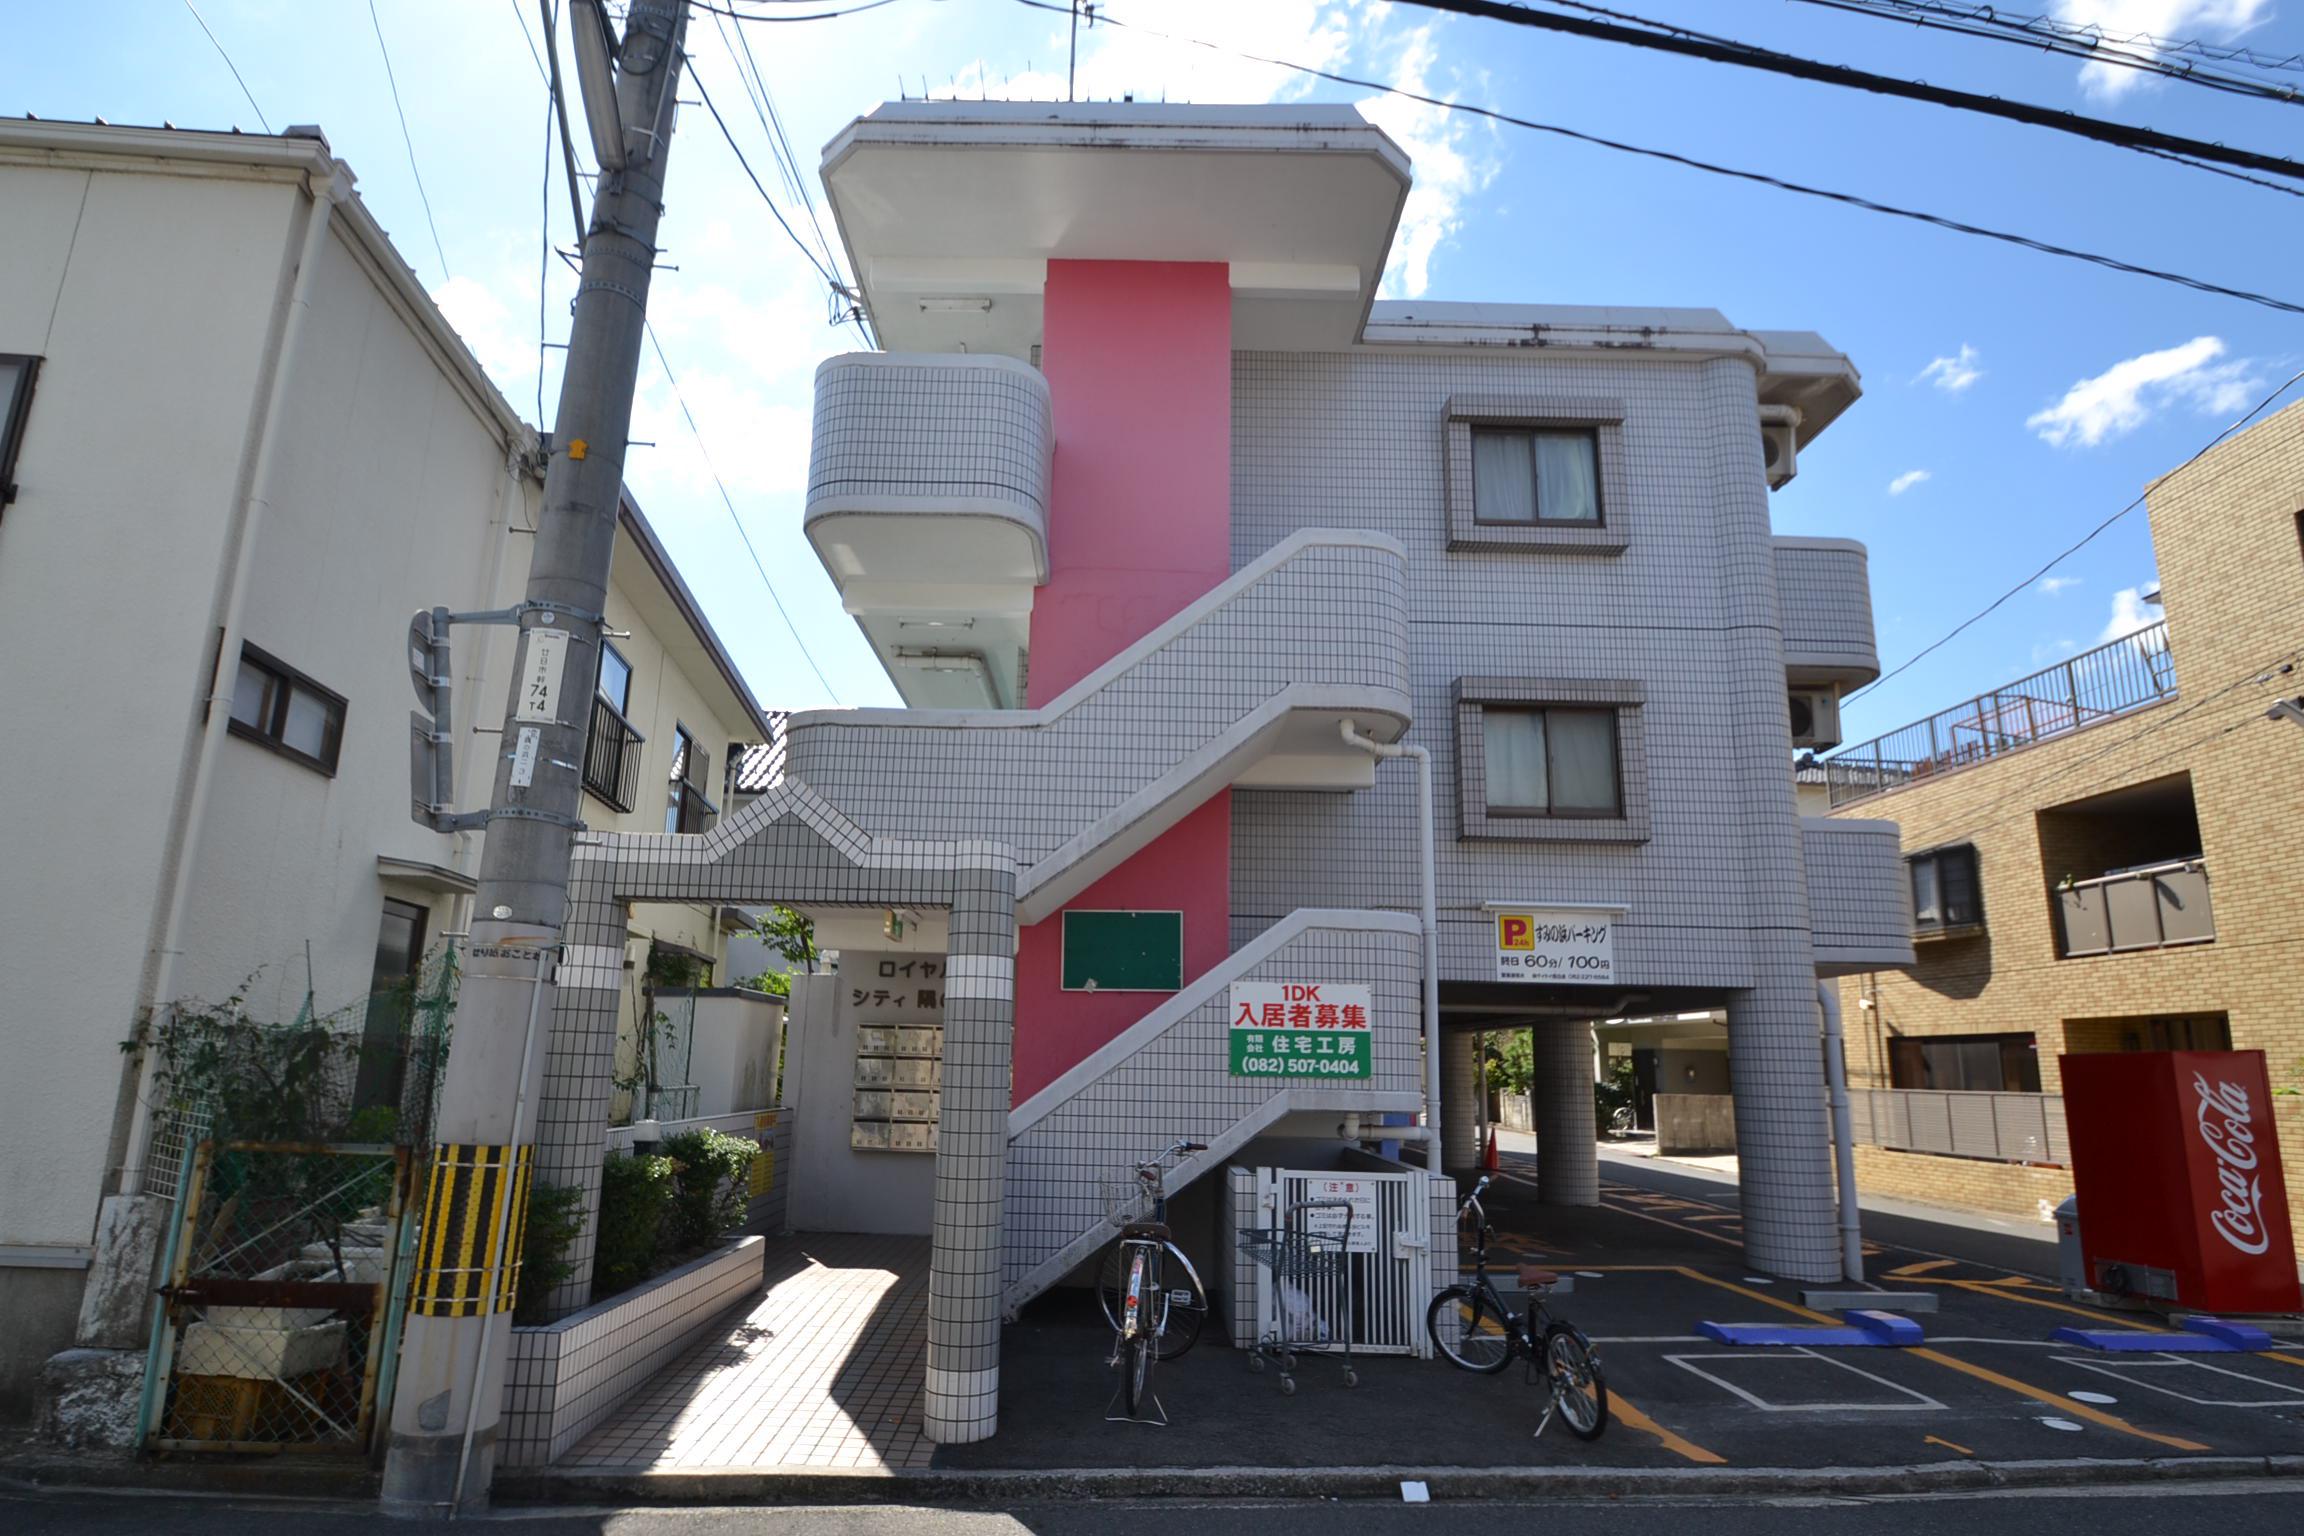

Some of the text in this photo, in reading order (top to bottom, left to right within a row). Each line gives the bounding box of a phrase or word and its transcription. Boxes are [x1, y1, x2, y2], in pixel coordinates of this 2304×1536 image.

[530, 684, 548, 698] 74
[529, 700, 546, 712] T4
[1282, 985, 1320, 1002] 1DK
[1234, 1003, 1367, 1029] 入居者募集
[1272, 1035, 1357, 1055] 住宅工房
[1242, 1056, 1360, 1074] (082) 507-0404
[2192, 1070, 2269, 1255] Coca-Cola
